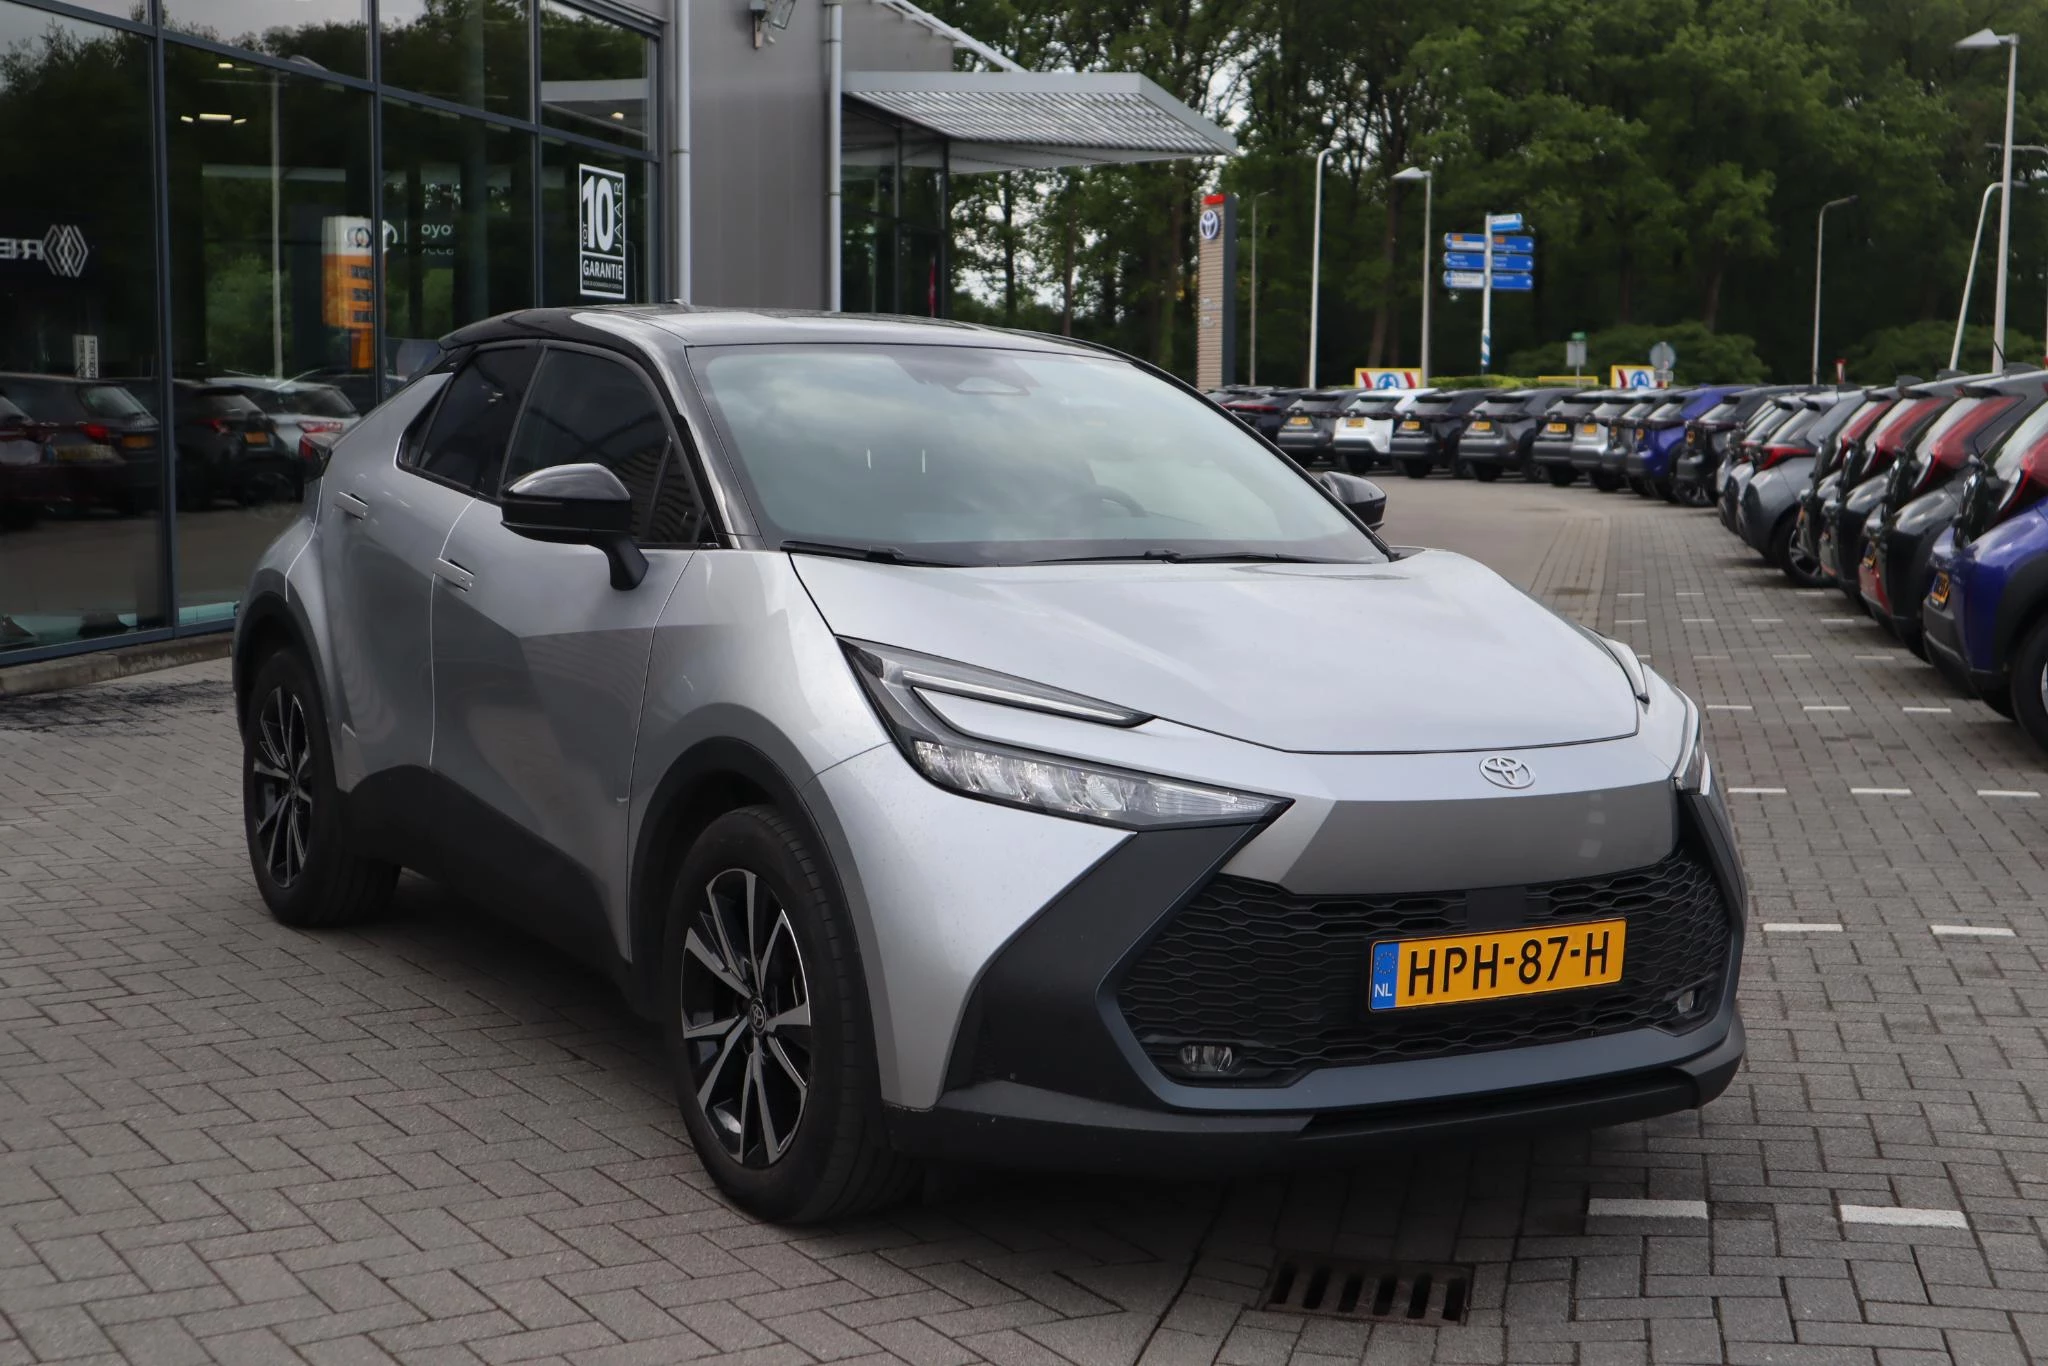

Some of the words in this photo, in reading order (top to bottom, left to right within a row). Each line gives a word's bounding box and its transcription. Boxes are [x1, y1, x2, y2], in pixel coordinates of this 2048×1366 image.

[421, 223, 454, 239] oyo
[582, 175, 614, 251] 10
[614, 181, 623, 253] JAAR
[582, 260, 623, 280] GARANTIE
[1408, 931, 1610, 996] HPH-87-H
[1374, 983, 1393, 998] NL
